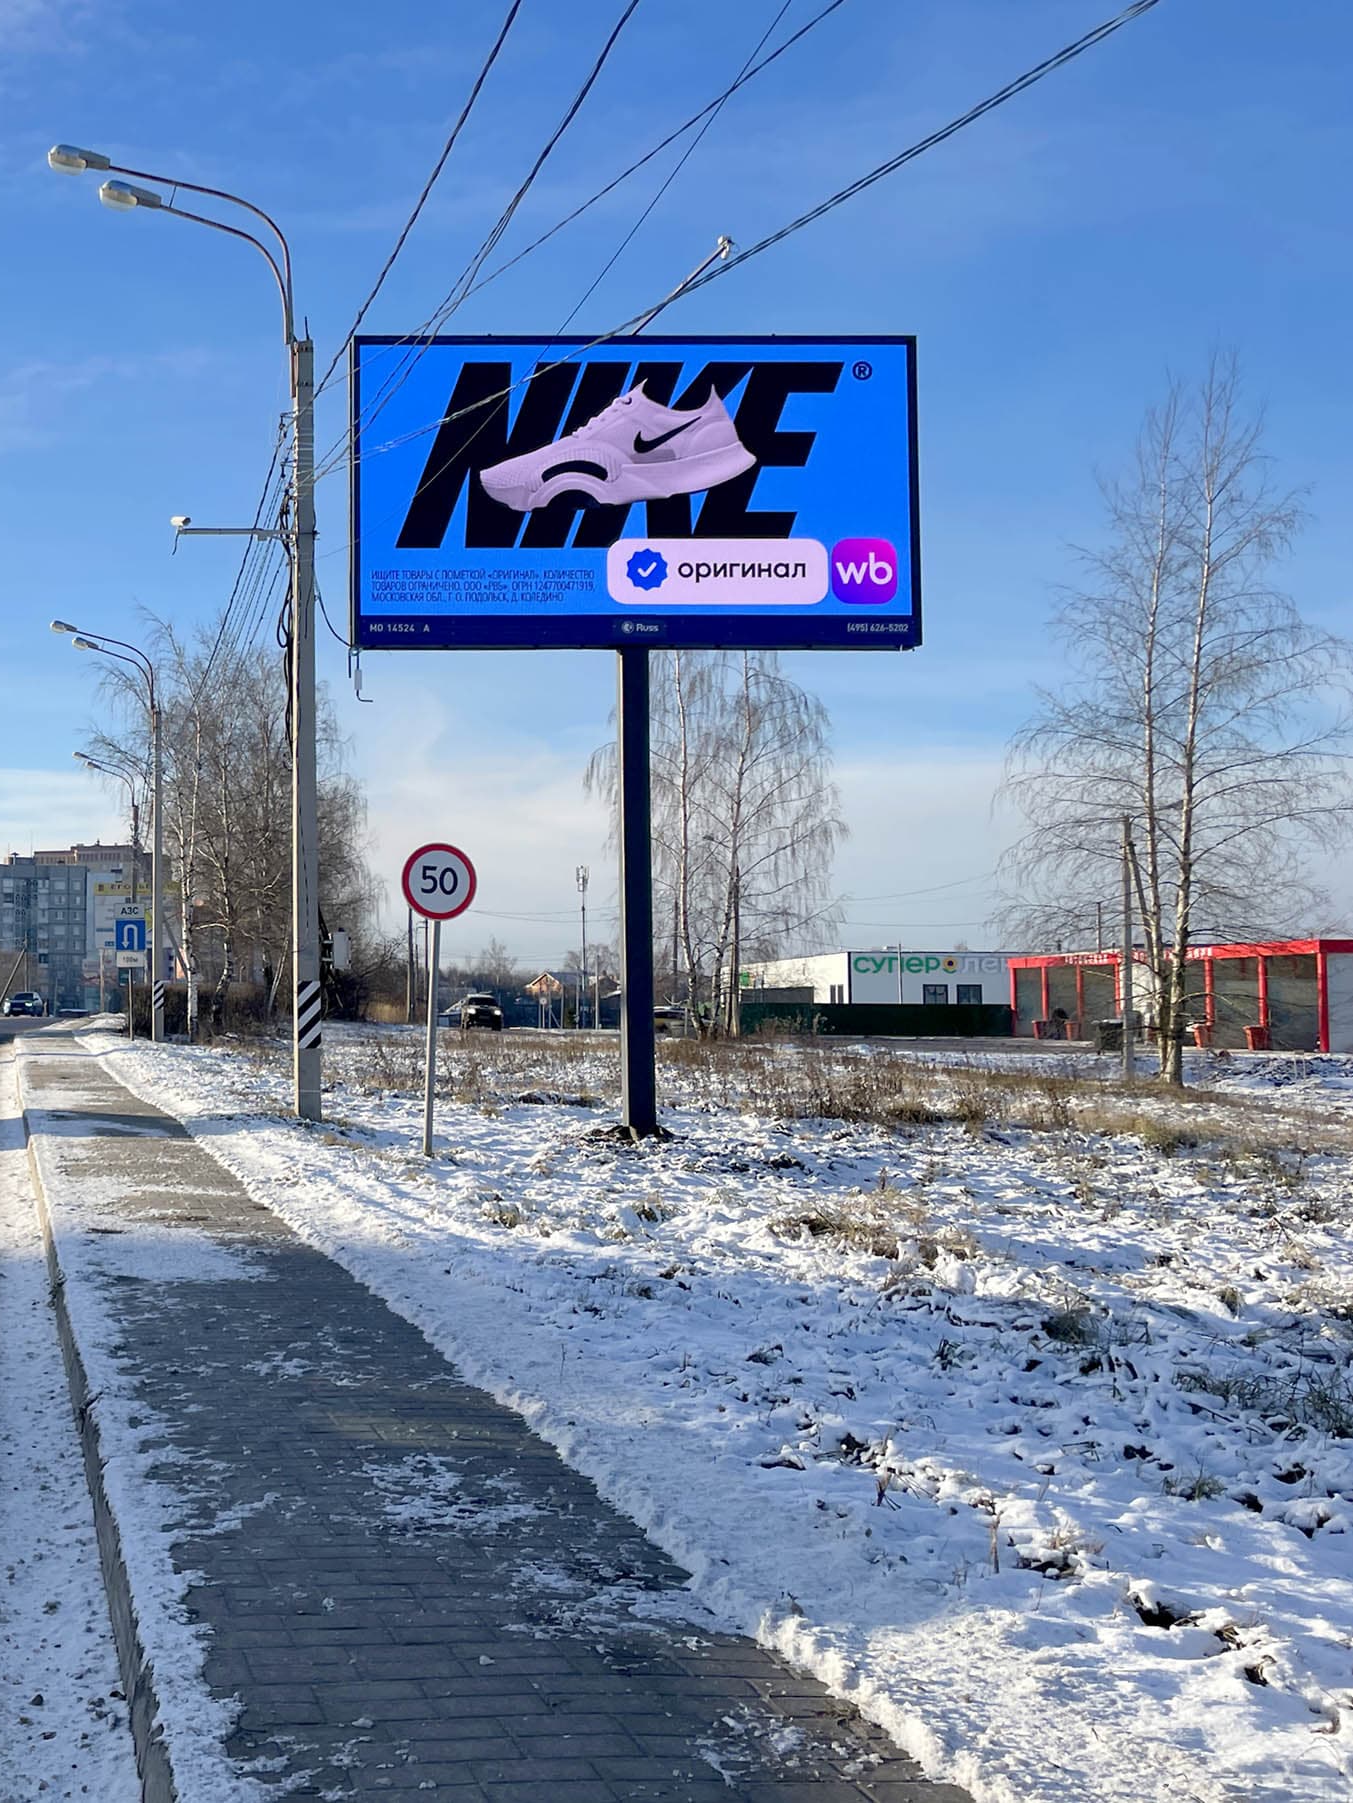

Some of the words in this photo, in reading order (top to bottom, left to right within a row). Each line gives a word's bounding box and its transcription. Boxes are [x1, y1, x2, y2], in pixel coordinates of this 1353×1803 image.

[395, 362, 844, 548] NIKE
[402, 569, 433, 580] ТОВАРЫ
[441, 567, 486, 580] ПОМЕТКОЙ
[543, 569, 595, 580] КОЛИЧЕСТВО
[678, 561, 807, 583] оригинал
[836, 552, 893, 585] wb
[371, 581, 406, 591] ТОВАРОВ
[463, 581, 481, 591] ООО
[511, 581, 533, 591] ОГРН
[371, 592, 424, 602] МОСКОВСКАЯ
[387, 623, 415, 633] 14524
[636, 623, 659, 632] Russ
[847, 622, 868, 632] (495)
[421, 865, 458, 896] 50
[120, 906, 139, 915] АЗС
